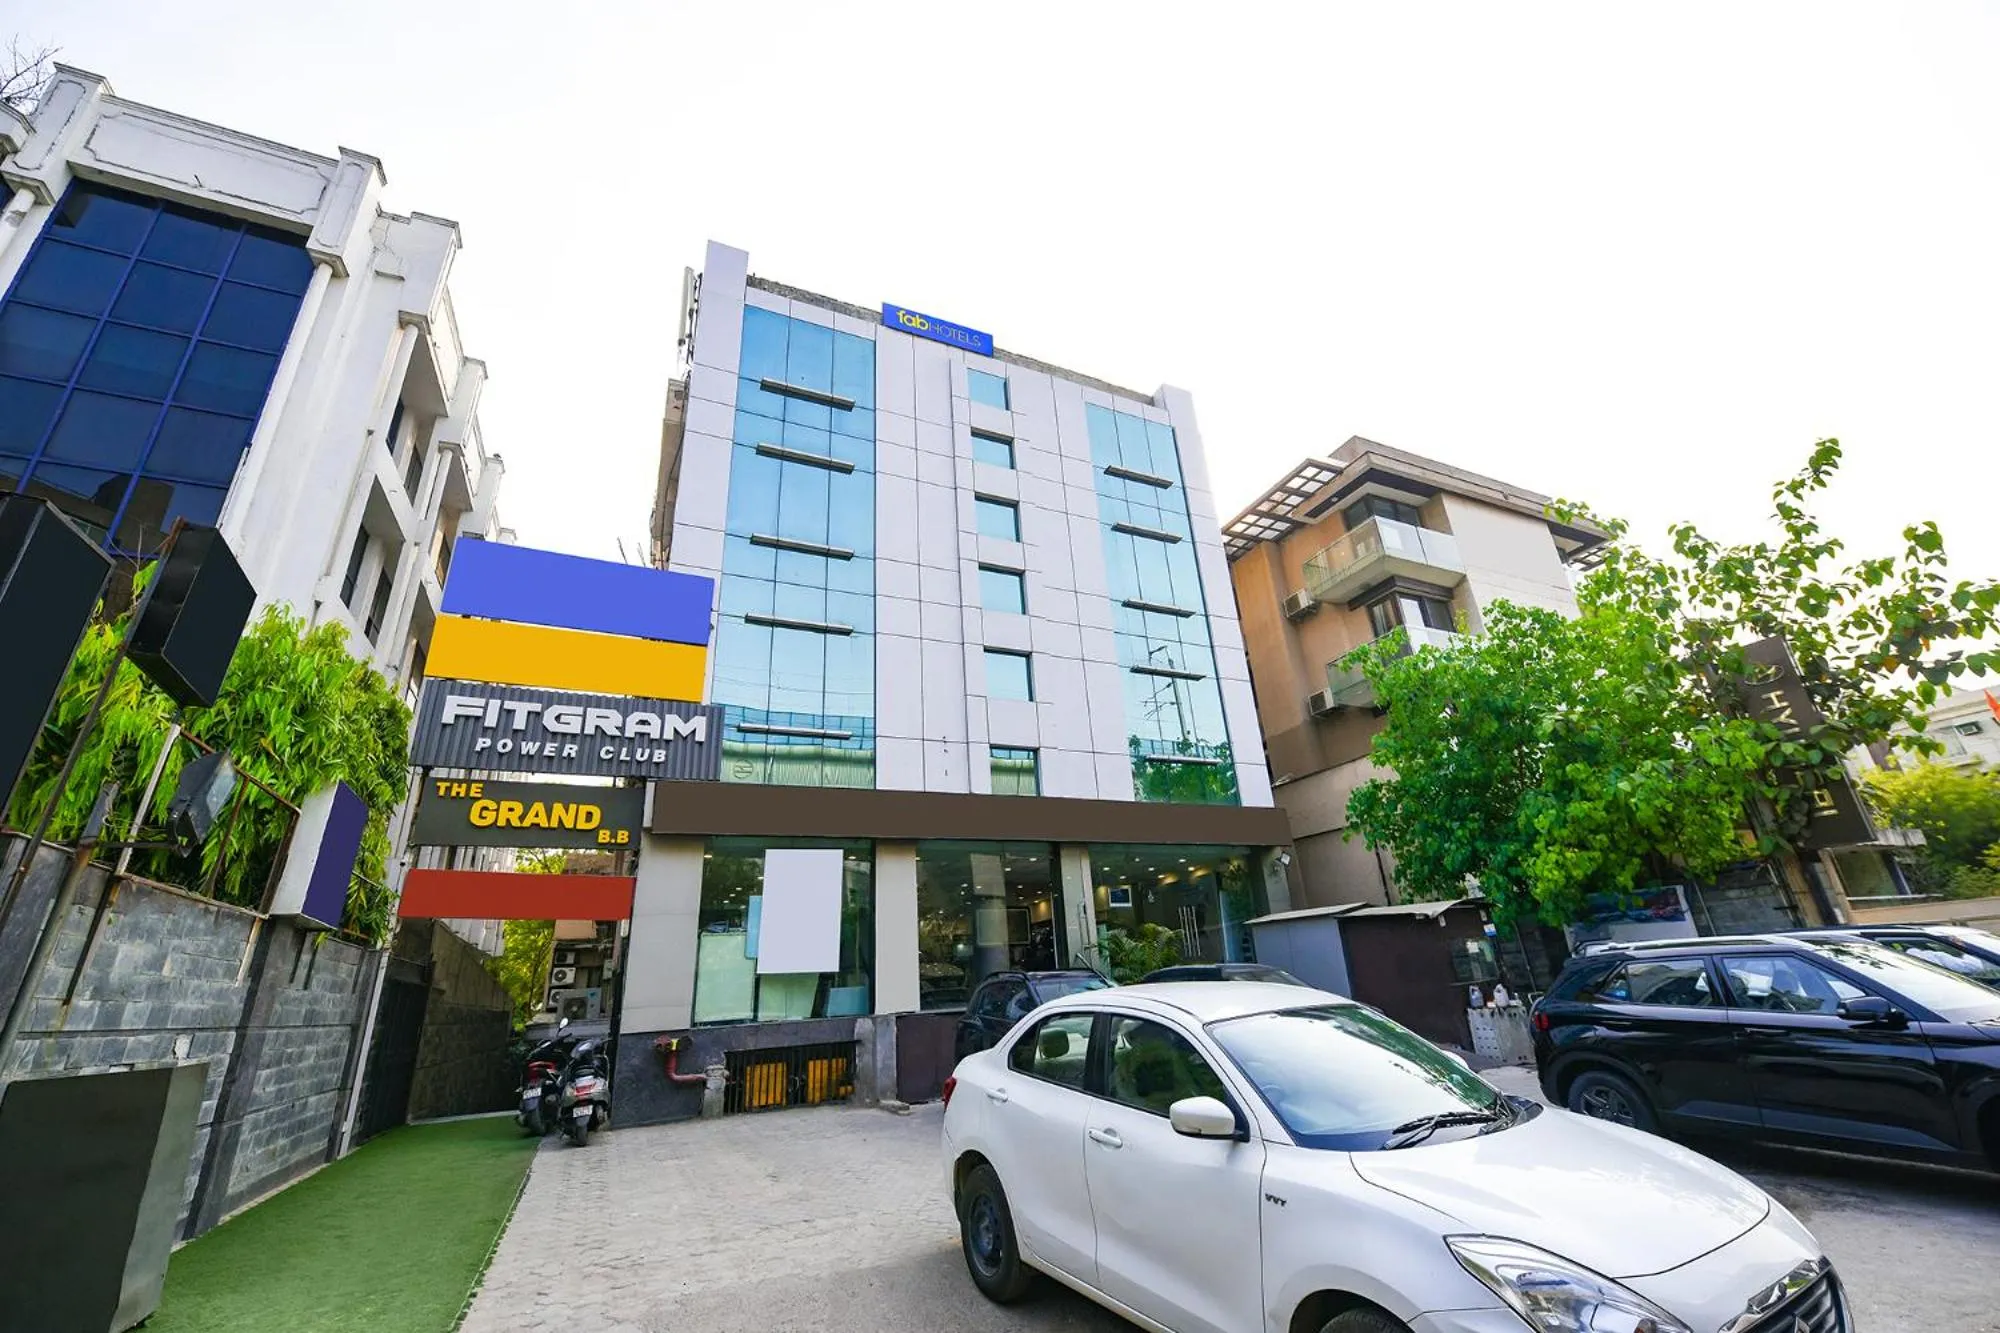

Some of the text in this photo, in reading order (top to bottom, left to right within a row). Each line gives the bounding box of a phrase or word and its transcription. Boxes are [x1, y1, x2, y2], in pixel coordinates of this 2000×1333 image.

[441, 695, 707, 742] FITGRAM
[475, 738, 667, 764] POWER CLUB
[436, 782, 484, 798] THE
[469, 799, 601, 830] GRAND
[597, 829, 630, 844] B.B
